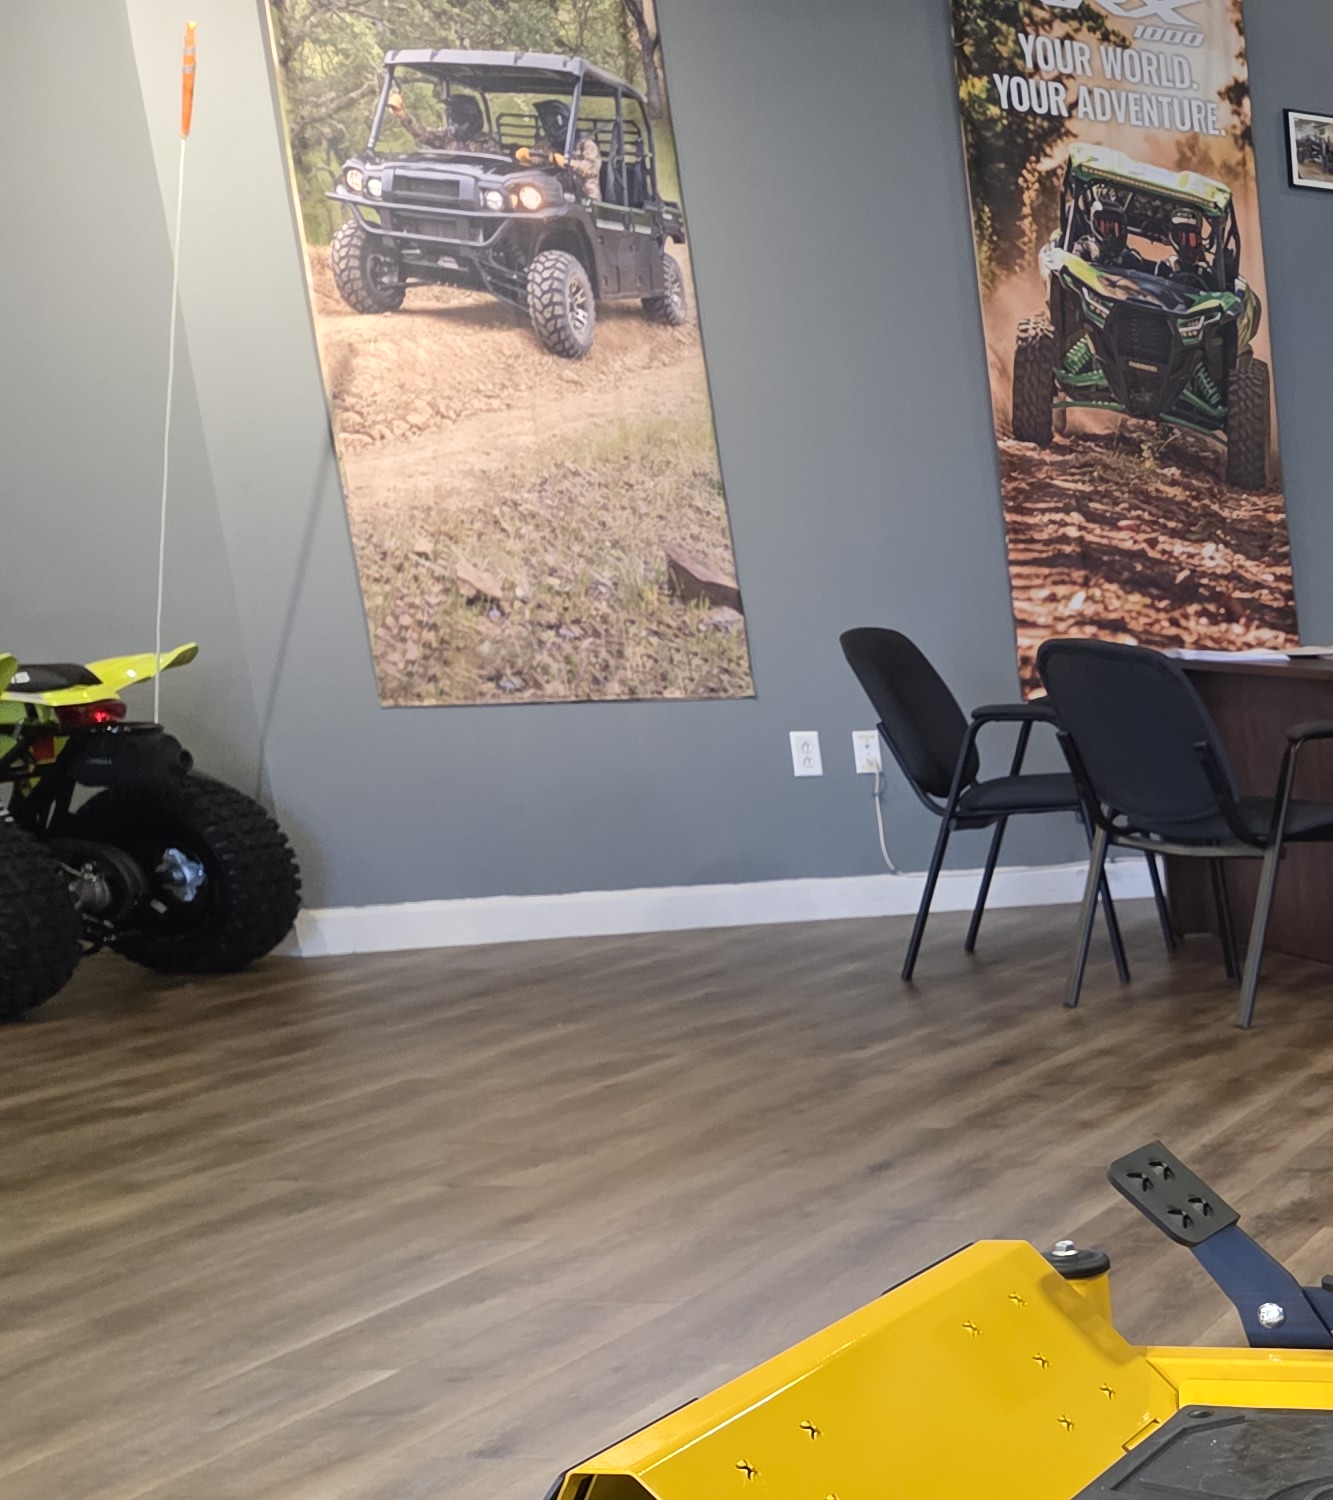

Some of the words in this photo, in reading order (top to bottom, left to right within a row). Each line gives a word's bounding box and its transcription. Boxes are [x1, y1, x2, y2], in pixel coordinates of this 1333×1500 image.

[1017, 32, 1094, 78] YOUR
[1100, 44, 1199, 90] WORLD.
[1132, 23, 1204, 48] 1000
[993, 73, 1069, 118] YOUR
[1077, 85, 1227, 137] ADVENTURE.
